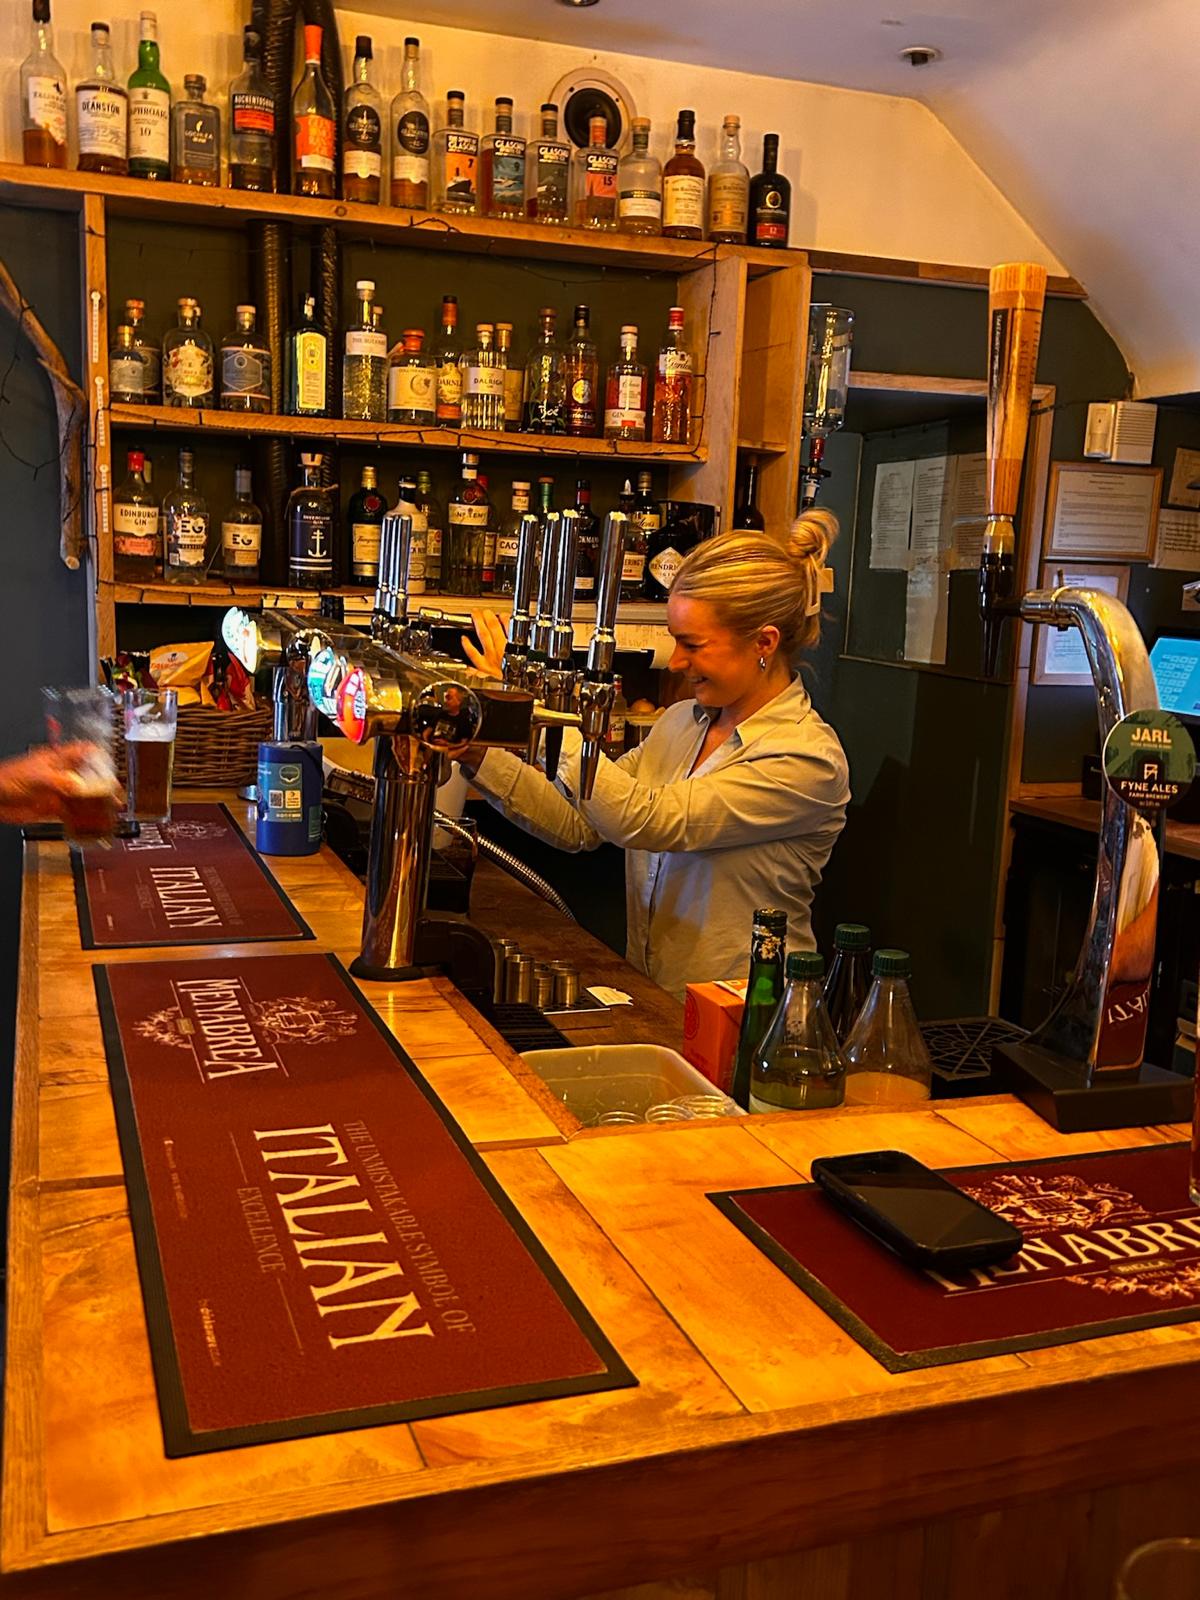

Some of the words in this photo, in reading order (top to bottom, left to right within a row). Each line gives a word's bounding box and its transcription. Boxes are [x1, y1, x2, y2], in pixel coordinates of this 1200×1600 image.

[82, 101, 120, 115] DEANSTON
[140, 127, 151, 136] 10
[495, 139, 525, 151] GLASGOW
[539, 146, 569, 158] GLASGOW
[468, 158, 474, 168] 7
[587, 155, 617, 166] GLASGOW
[603, 176, 613, 186] 15
[134, 518, 147, 526] GIN
[232, 533, 253, 546] EG
[1131, 728, 1172, 744] JARL
[1120, 781, 1149, 792] FYNE
[1151, 783, 1178, 794] ALES
[150, 867, 223, 929] ITALIAN
[177, 978, 279, 1080] MENABREA
[343, 1119, 372, 1144] THE
[354, 1143, 425, 1242] UNMISTAKABLE
[236, 1186, 288, 1273] EXCELLENCE
[253, 1123, 435, 1350] ITALIAN
[406, 1243, 461, 1305] SYMBOL
[441, 1307, 476, 1333] OF
